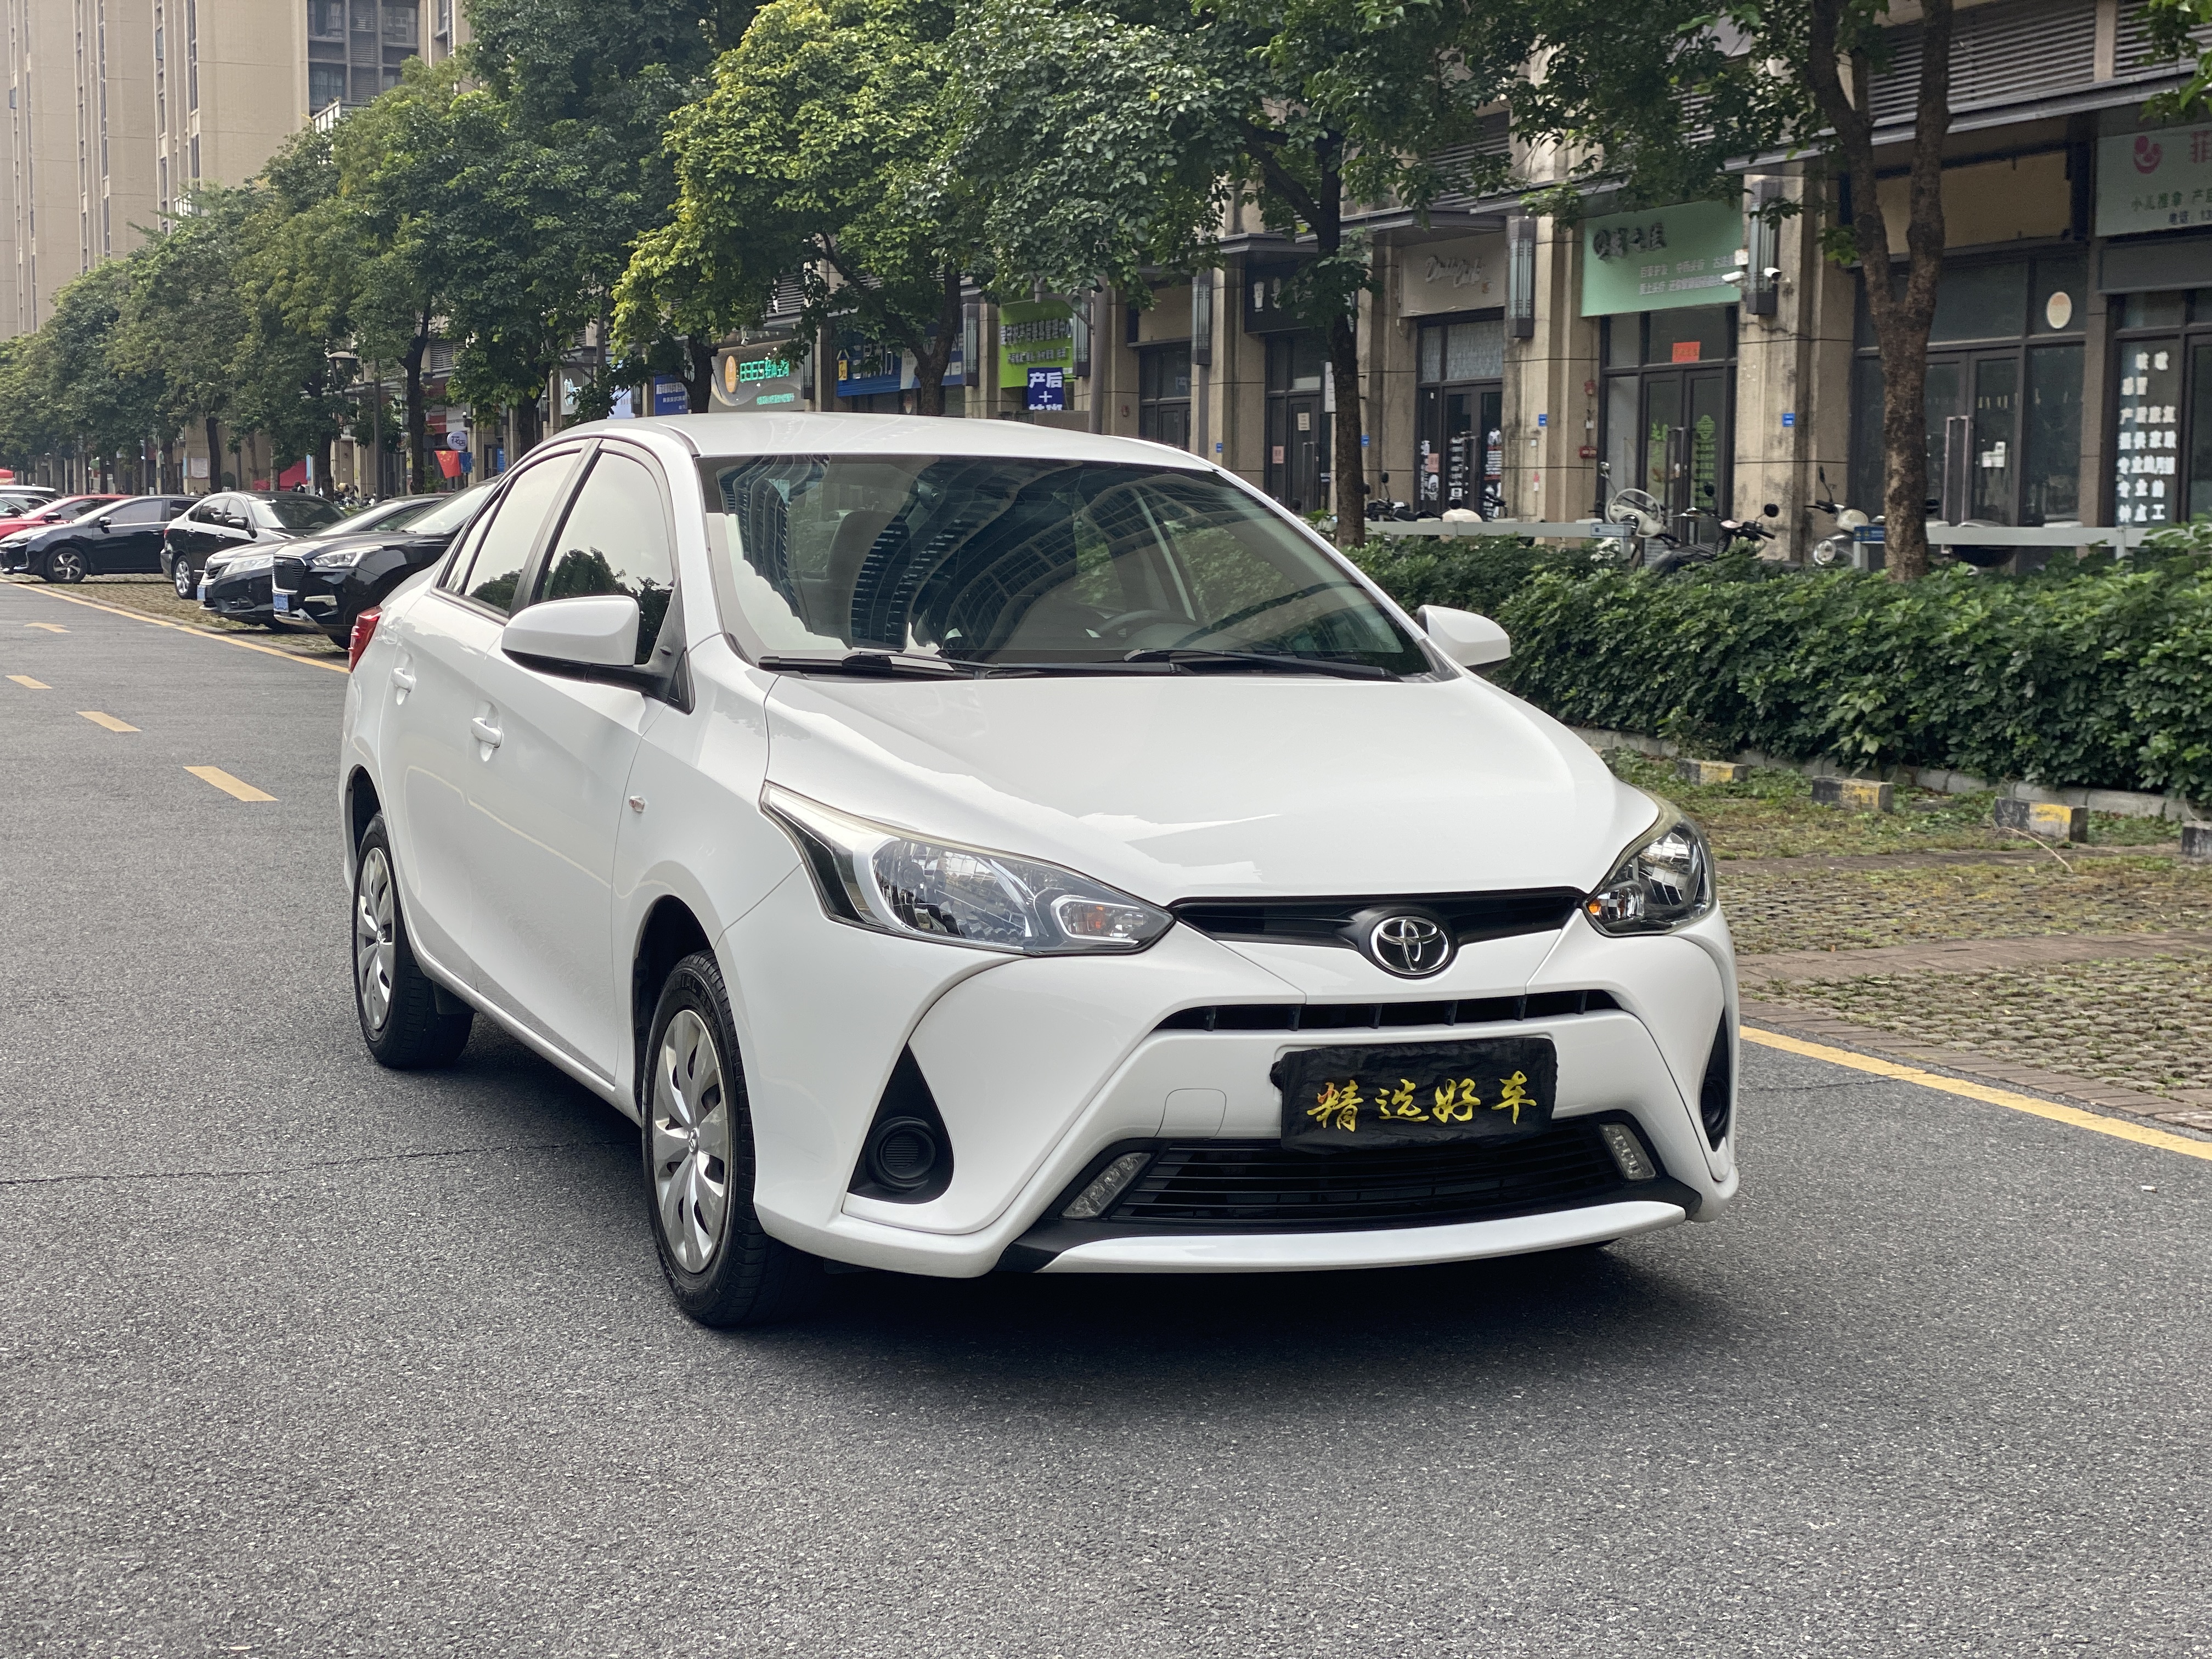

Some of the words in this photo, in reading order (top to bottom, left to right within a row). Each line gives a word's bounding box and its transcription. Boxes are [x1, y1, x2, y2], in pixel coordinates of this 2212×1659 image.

[1029, 372, 1063, 388] 产后
[1307, 1070, 1537, 1132] 精选好车
